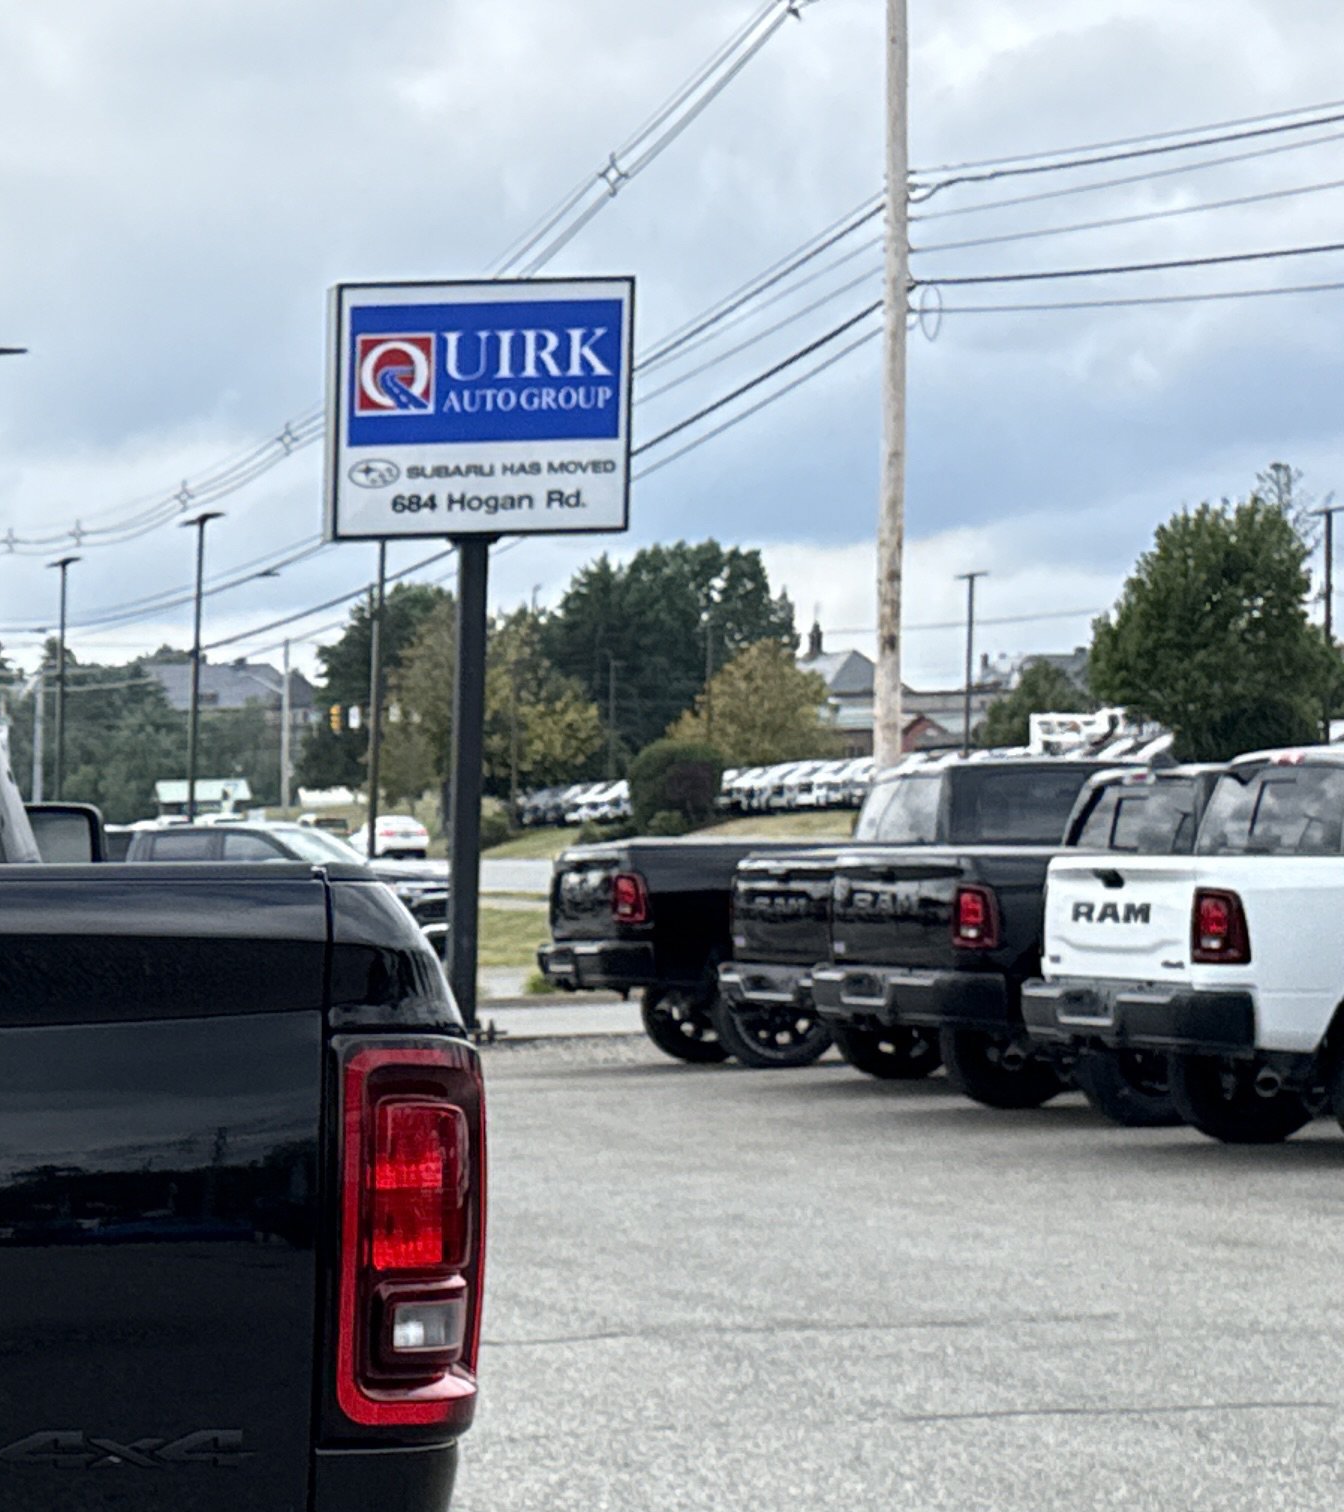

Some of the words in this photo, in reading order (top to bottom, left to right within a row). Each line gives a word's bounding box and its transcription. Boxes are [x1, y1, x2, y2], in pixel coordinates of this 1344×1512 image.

[360, 327, 613, 410] QUIRK
[405, 464, 495, 480] SUBARU
[501, 461, 542, 476] HAS
[547, 459, 617, 475] MOVED
[391, 493, 438, 514] 684
[447, 491, 534, 515] Hogan
[546, 488, 587, 509] Rd.
[1071, 901, 1152, 924] RAM
